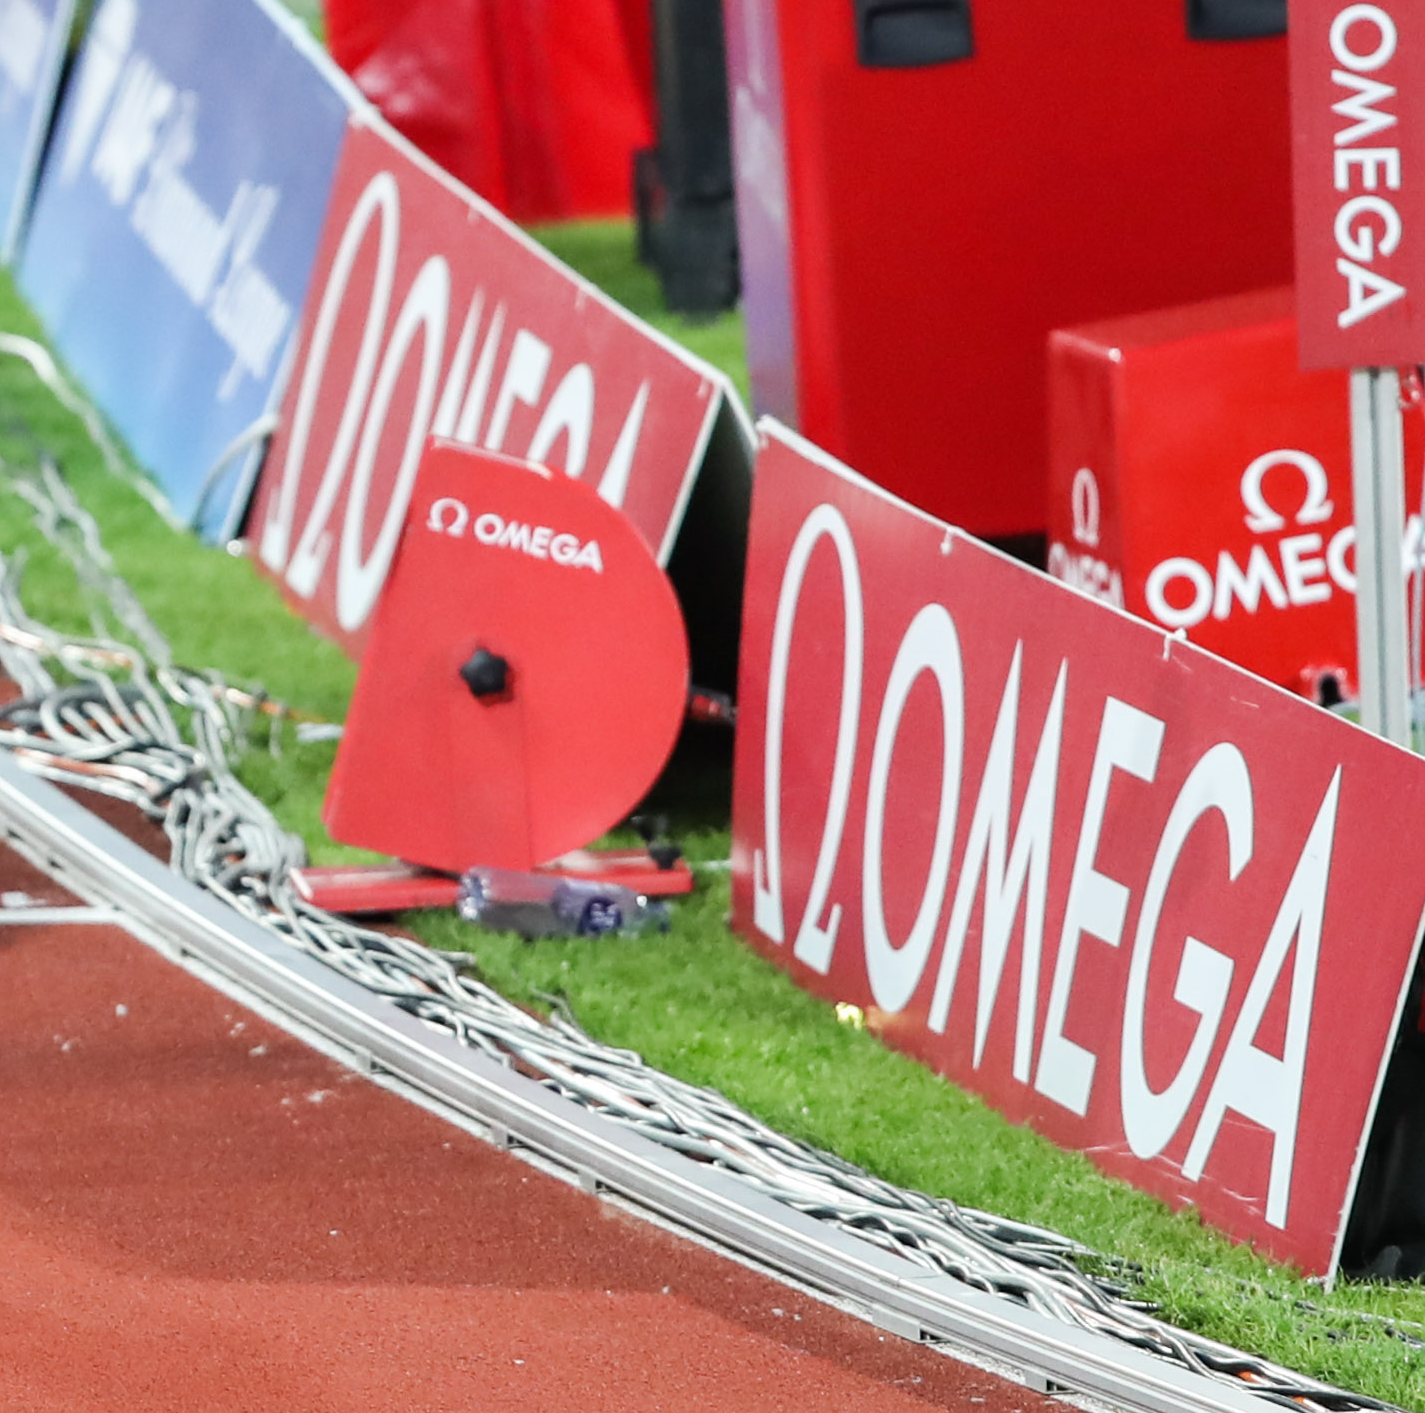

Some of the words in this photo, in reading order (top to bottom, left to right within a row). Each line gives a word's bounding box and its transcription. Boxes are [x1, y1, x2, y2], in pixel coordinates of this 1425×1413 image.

[1329, 3, 1406, 328] OMEGA
[473, 513, 604, 575] OMEGA
[862, 602, 1342, 1230] OMEGA
